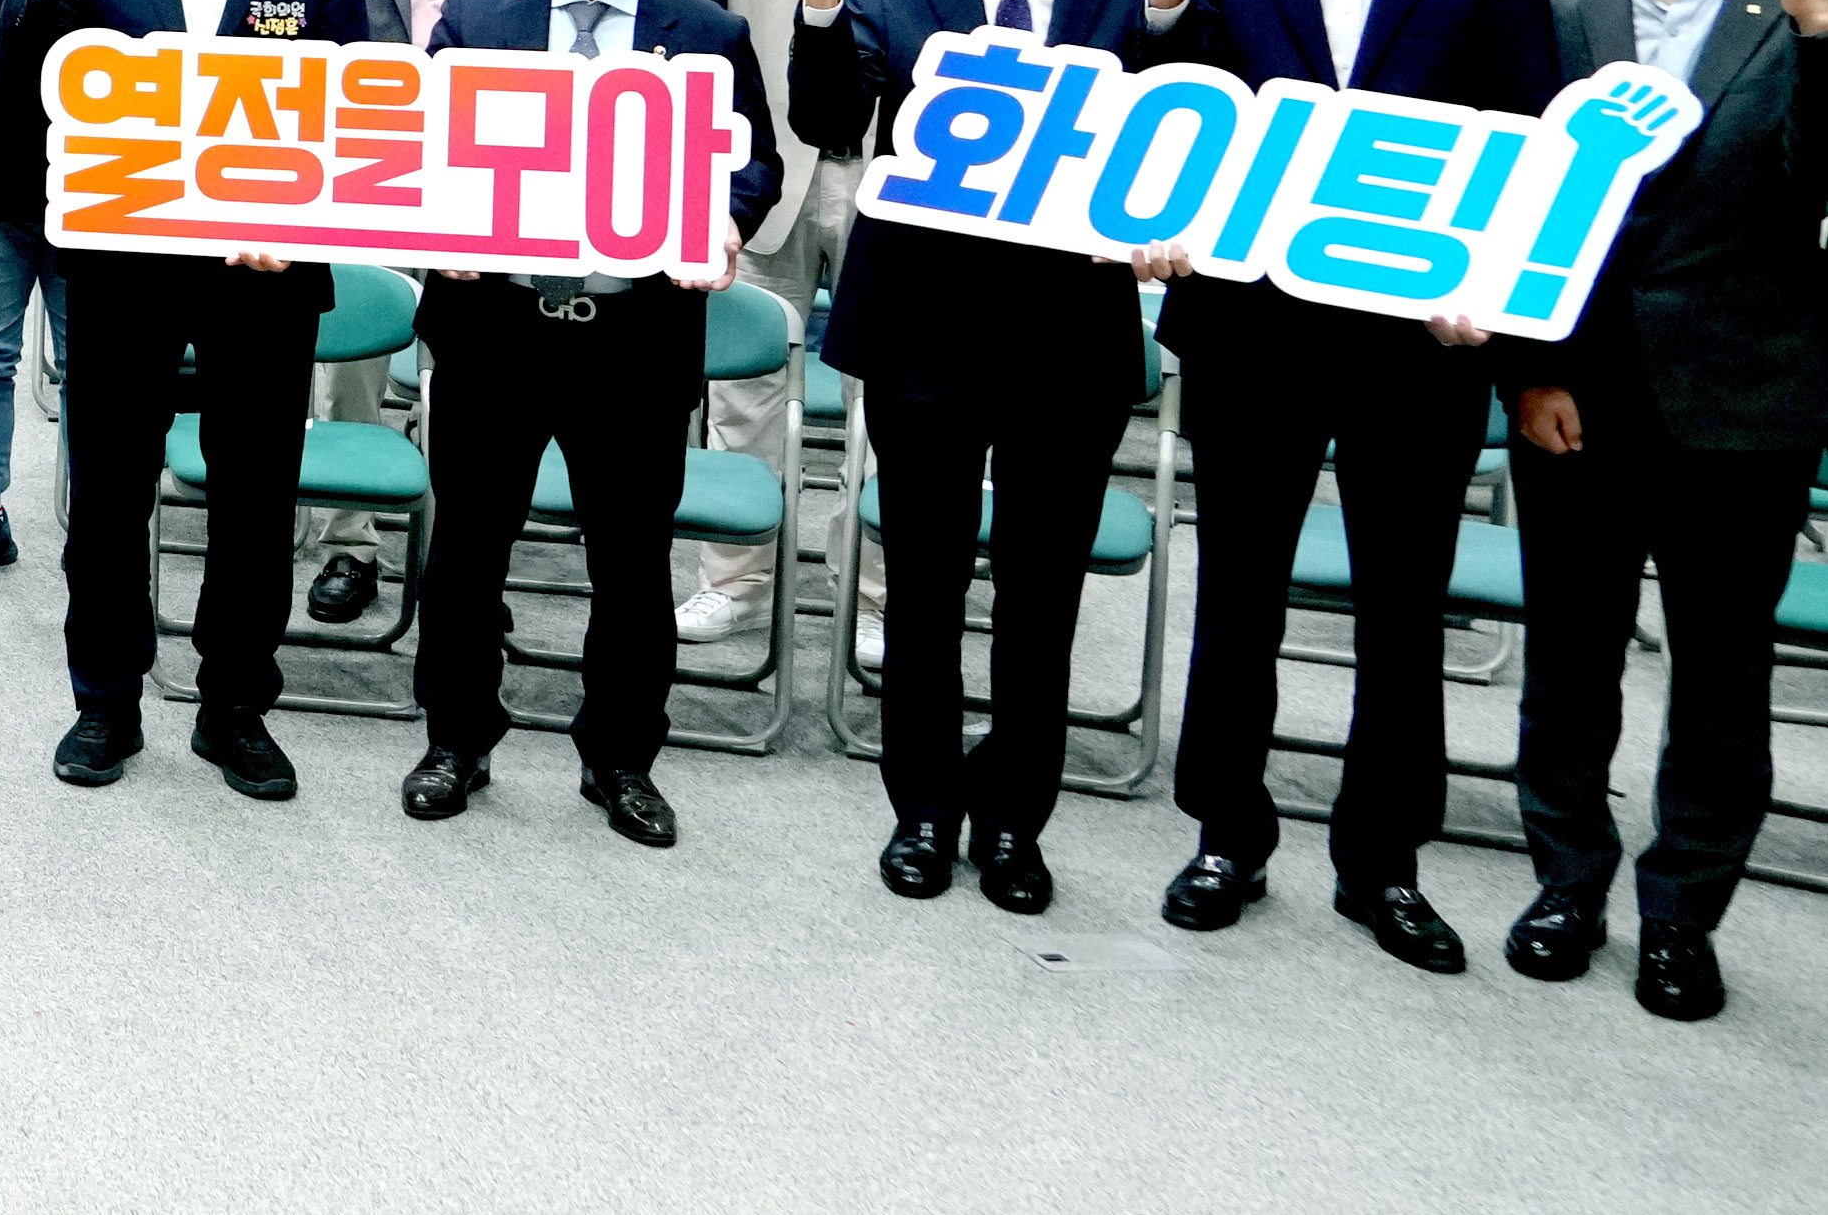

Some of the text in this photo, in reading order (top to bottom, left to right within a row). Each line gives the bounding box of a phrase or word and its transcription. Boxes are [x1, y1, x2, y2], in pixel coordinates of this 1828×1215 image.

[250, 0, 306, 18] 국회의원
[58, 45, 732, 265] 열정을 모아
[877, 44, 1678, 321] 화이팅!
